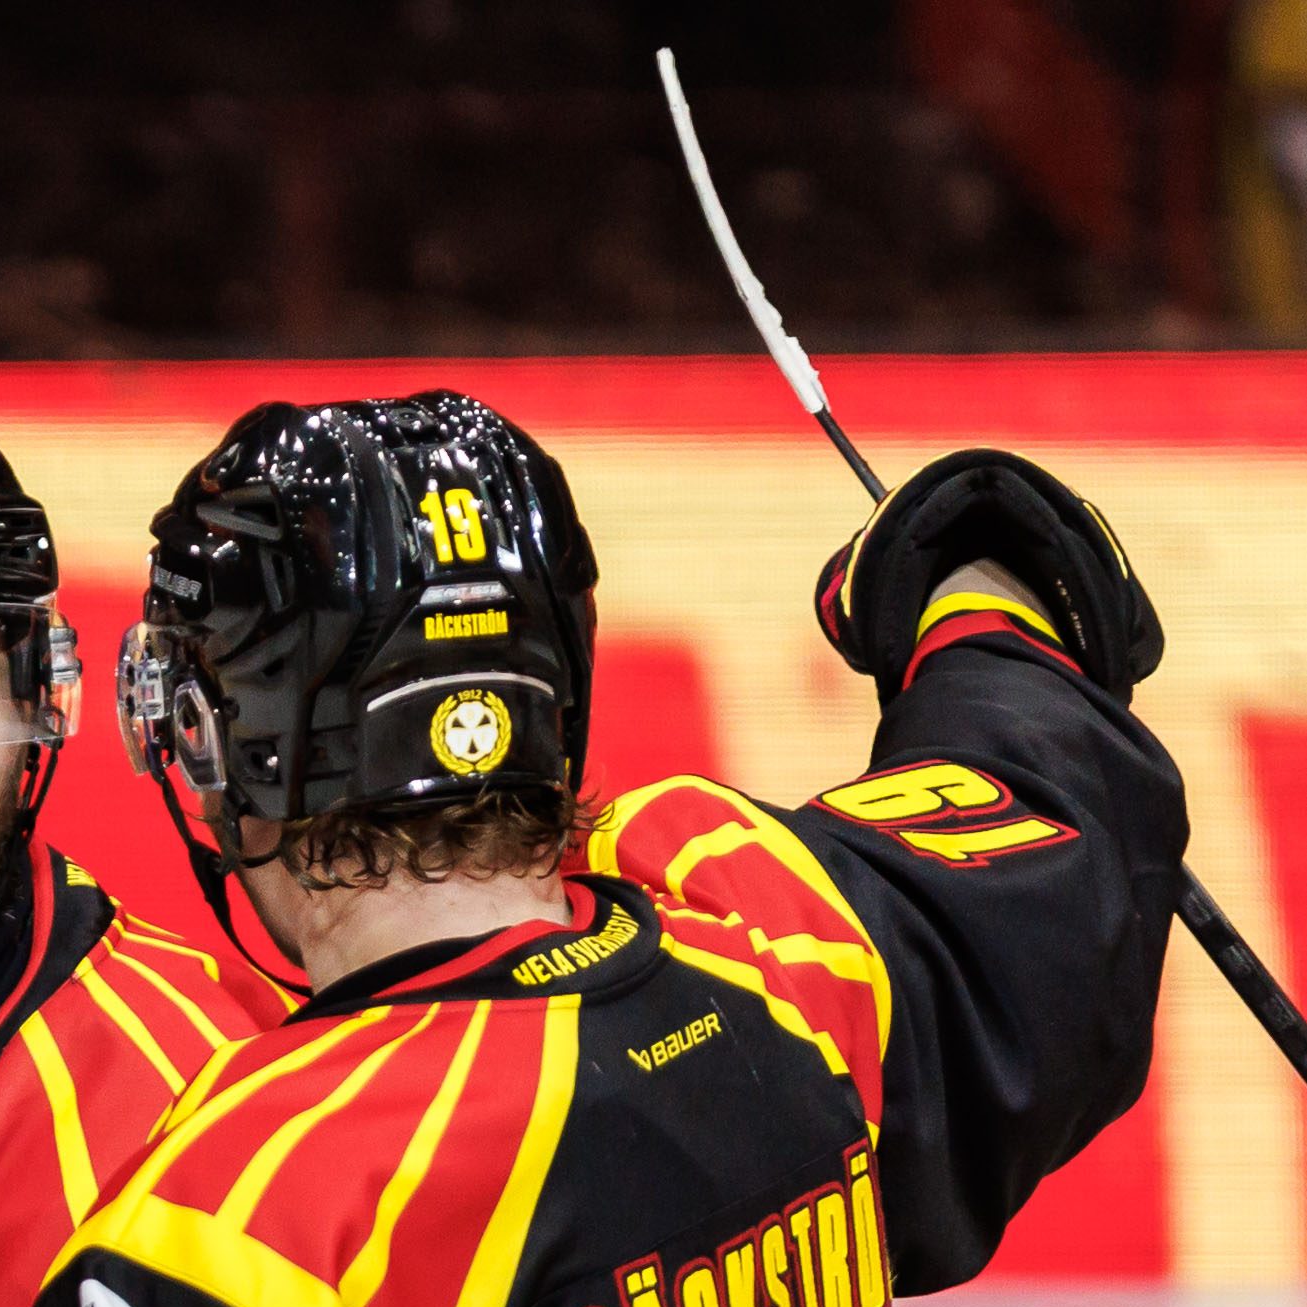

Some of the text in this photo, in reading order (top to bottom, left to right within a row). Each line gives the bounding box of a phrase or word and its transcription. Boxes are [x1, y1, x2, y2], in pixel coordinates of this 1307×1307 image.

[420, 487, 487, 564] 19
[424, 608, 509, 640] BÄCKSTRÖM
[457, 689, 483, 702] 1912
[512, 947, 577, 985] HELA
[650, 1012, 722, 1067] BAUER
